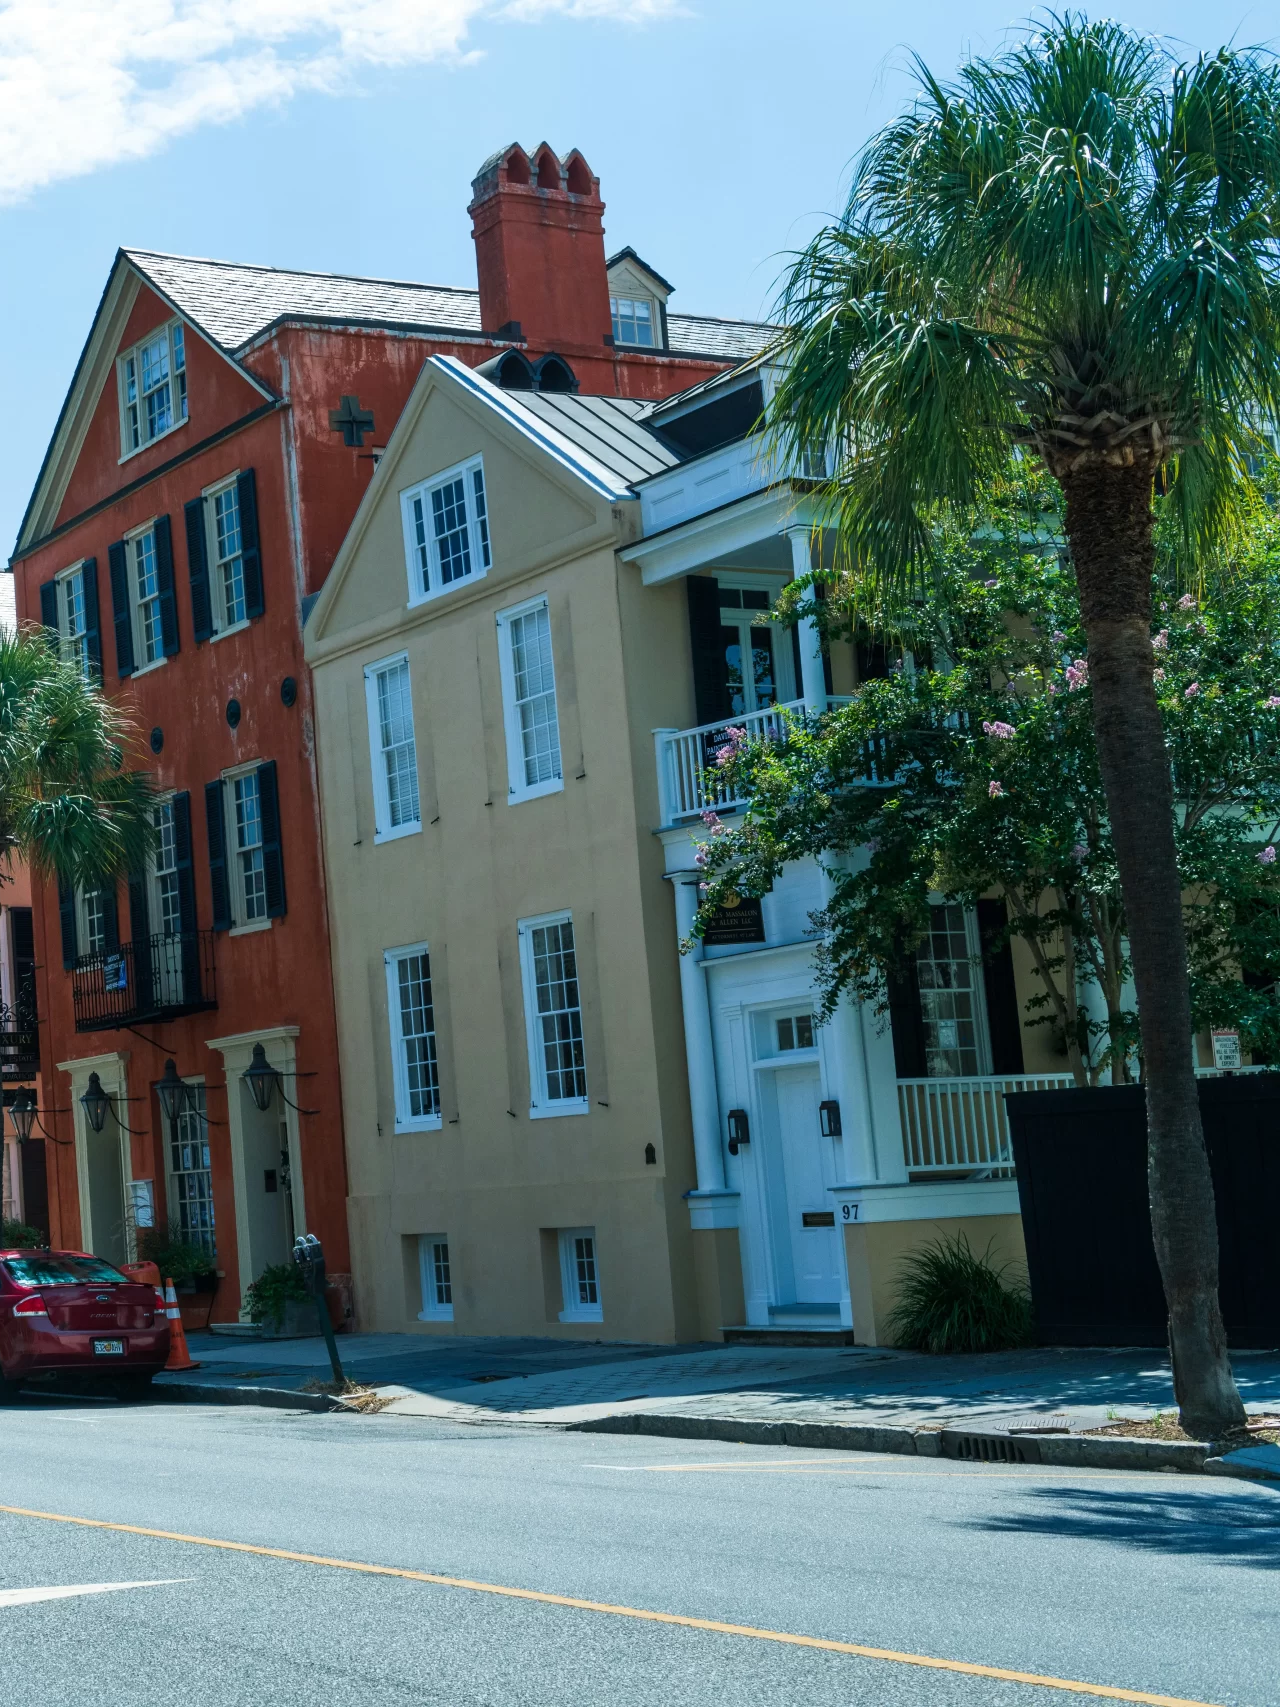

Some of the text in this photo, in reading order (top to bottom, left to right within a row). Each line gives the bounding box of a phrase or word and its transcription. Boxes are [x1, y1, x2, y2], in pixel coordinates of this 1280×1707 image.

[725, 910, 757, 918] MASSALON
[2, 1034, 32, 1044] XURY
[9, 1055, 35, 1063] ESTATE
[3, 1072, 35, 1080] OVATION
[842, 1204, 859, 1220] 97
